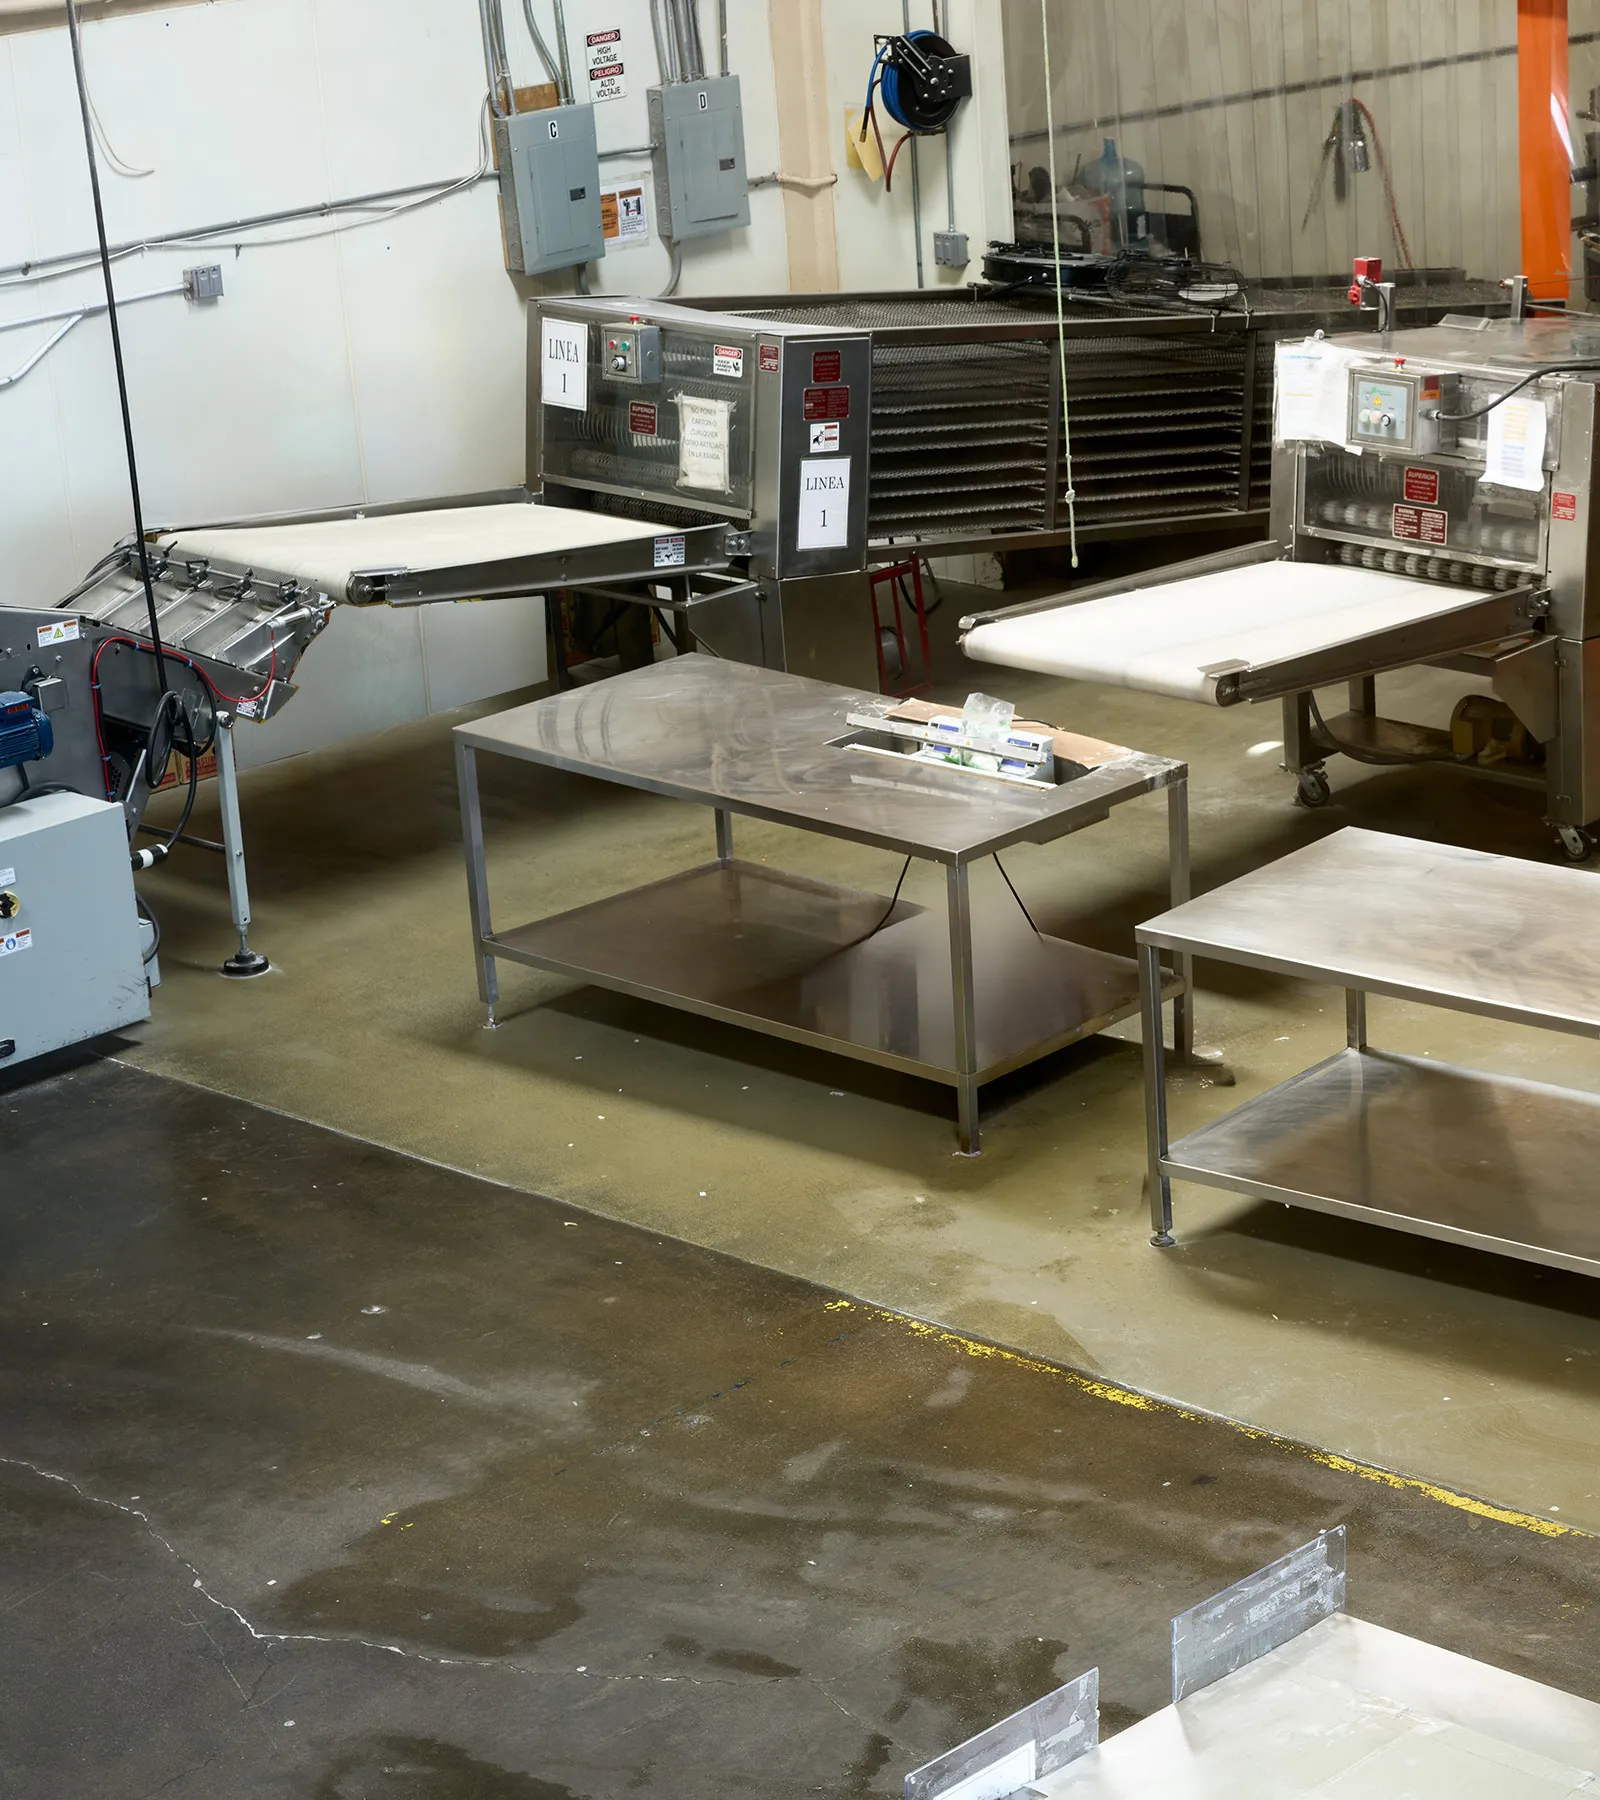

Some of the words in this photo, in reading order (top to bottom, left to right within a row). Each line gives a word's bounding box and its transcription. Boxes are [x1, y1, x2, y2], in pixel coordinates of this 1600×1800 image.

[591, 32, 616, 44] DANGER
[597, 46, 611, 55] HIGH
[592, 54, 618, 65] VOLTAGE
[594, 66, 620, 77] PELIGRO
[600, 78, 615, 88] ALTO
[596, 86, 621, 98] VOLTAJE
[699, 94, 707, 109] D
[549, 122, 557, 138] C
[548, 338, 579, 363] LINEA
[719, 348, 738, 357] DANGER
[562, 373, 567, 393] 1
[631, 405, 655, 414] SUPERIOR
[1407, 471, 1436, 480] SUPERIOR
[806, 476, 845, 490] LINEA
[820, 509, 827, 527] 1
